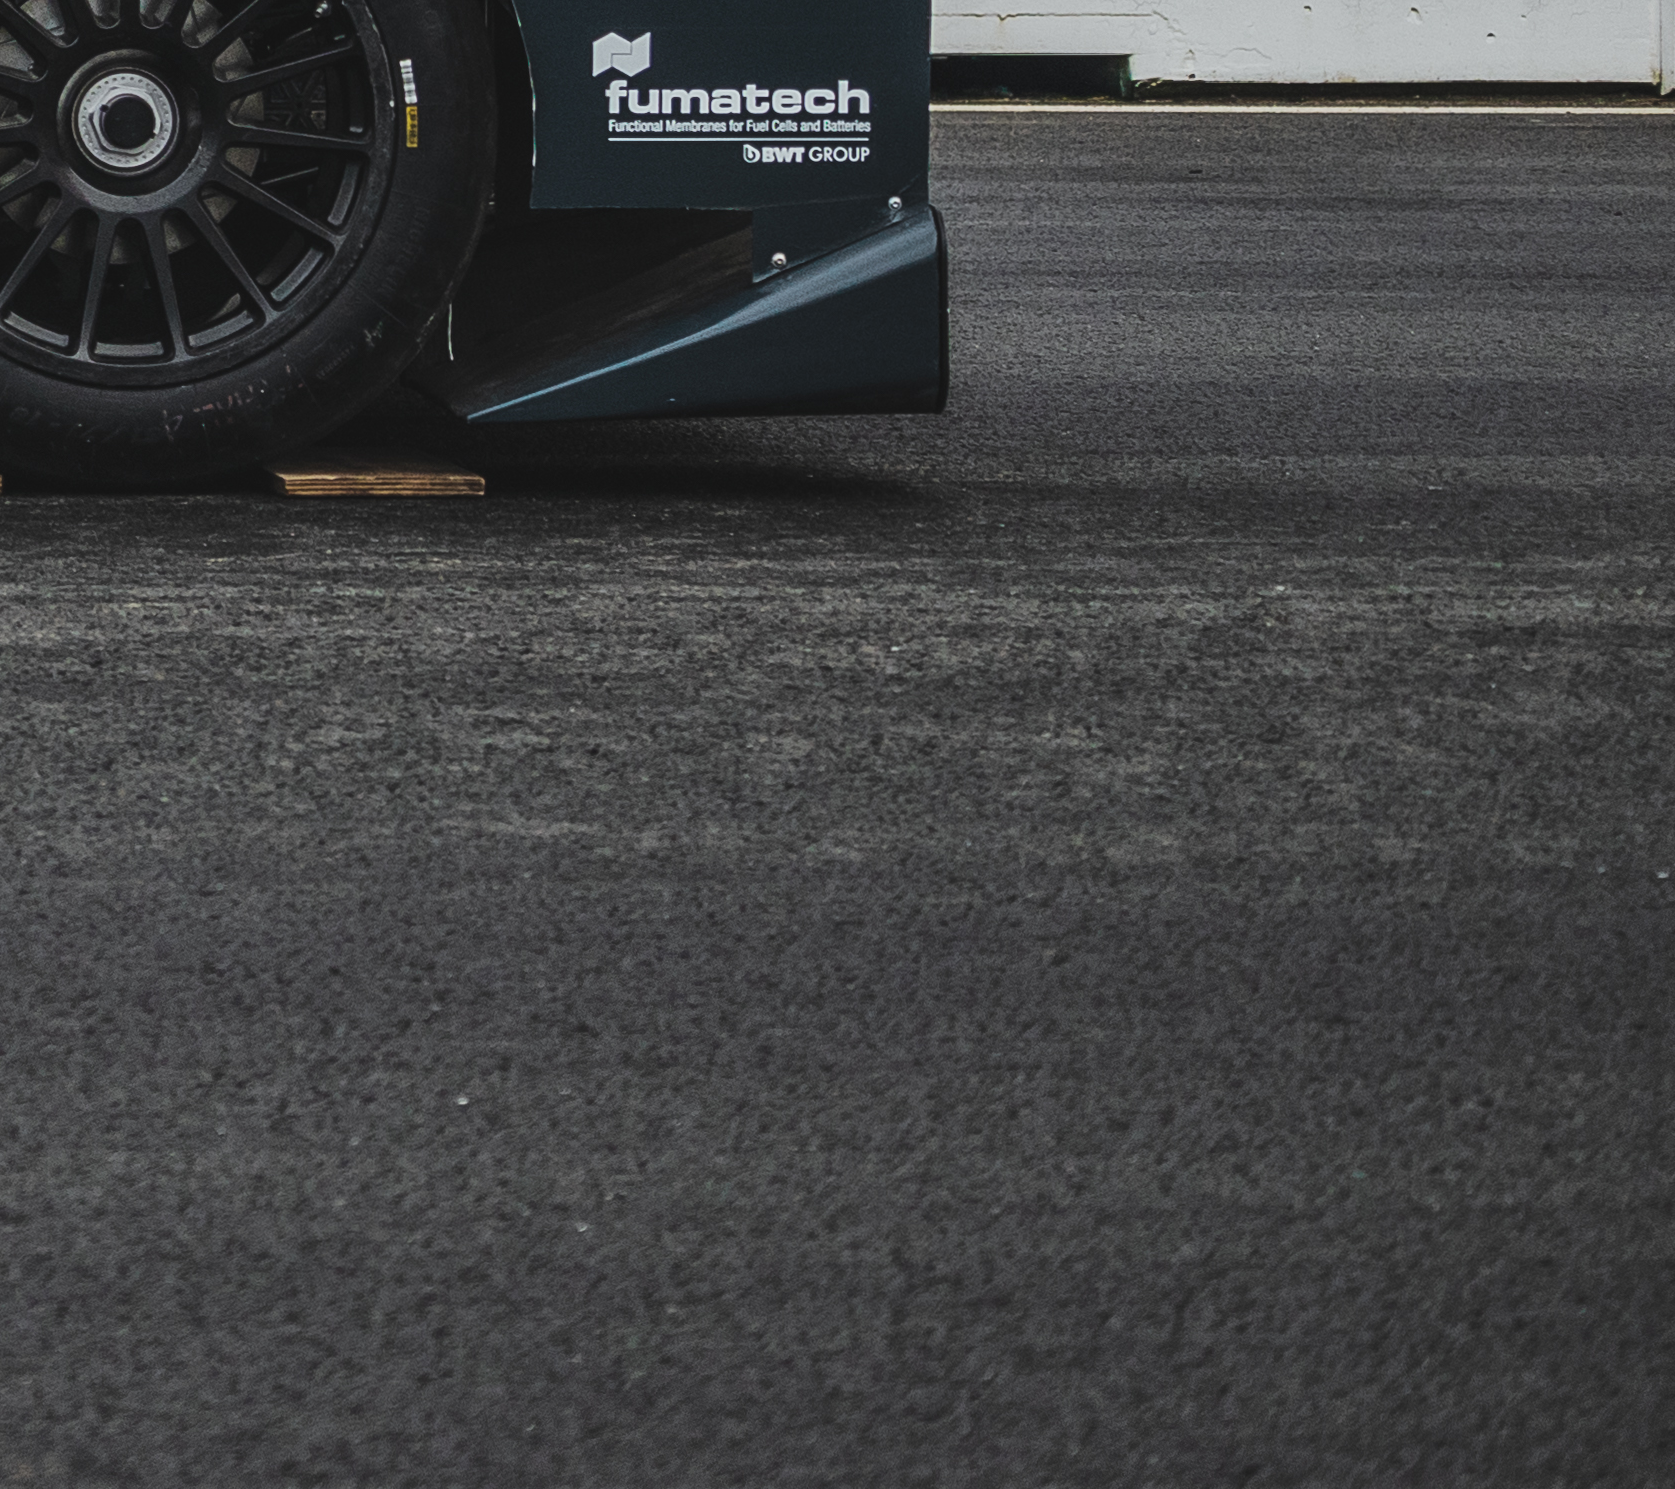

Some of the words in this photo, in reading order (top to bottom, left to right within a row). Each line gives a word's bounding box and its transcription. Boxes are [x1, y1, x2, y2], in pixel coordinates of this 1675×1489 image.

[605, 79, 870, 114] fumatech
[608, 119, 663, 133] Functional
[666, 119, 727, 133] Membranes
[729, 119, 745, 132] for
[746, 119, 769, 132] Fuel
[771, 119, 798, 133] Cells
[800, 119, 821, 133] and
[823, 119, 871, 133] Batteries
[761, 147, 805, 163] BWT
[808, 147, 870, 163] GROUP
